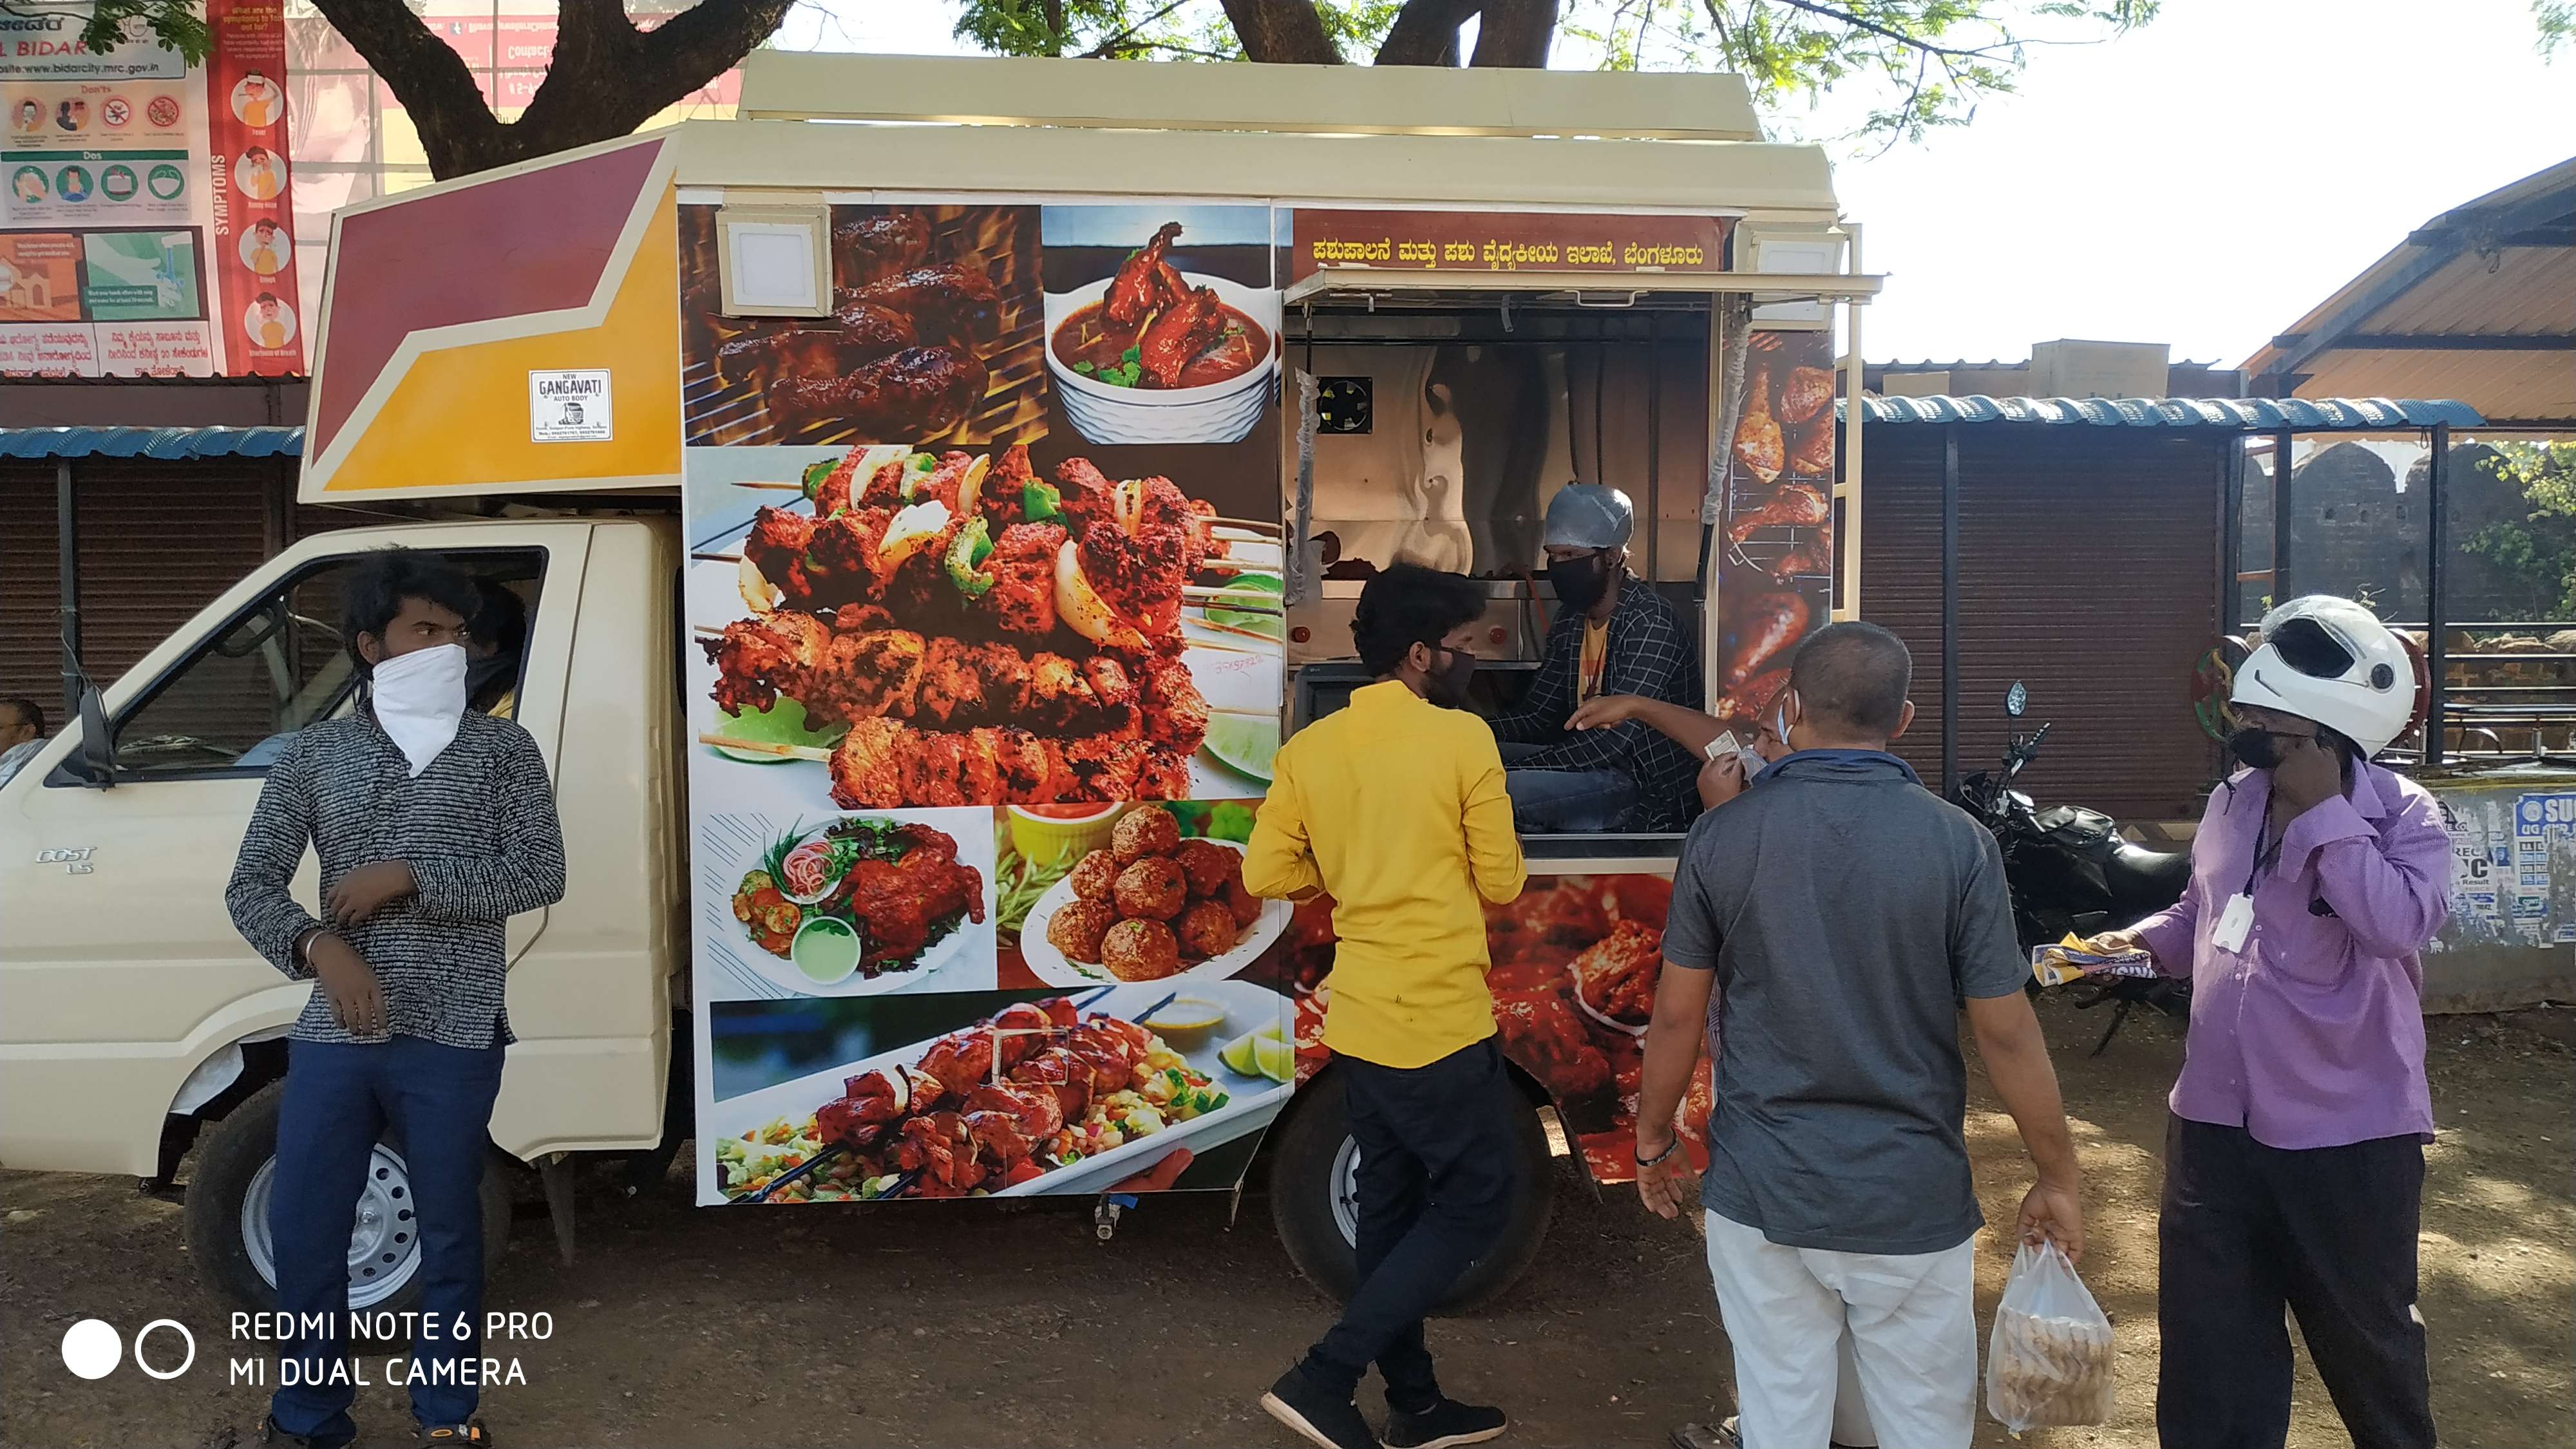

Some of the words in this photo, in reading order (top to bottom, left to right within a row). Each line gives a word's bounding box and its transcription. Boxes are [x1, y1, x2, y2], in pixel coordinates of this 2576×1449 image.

[17, 40, 88, 57] BIDAR
[83, 151, 102, 160] Dos
[211, 154, 229, 236] SYMPTOMS
[1313, 237, 1391, 260] ಪಶುಪಾಲನೆ
[1398, 238, 1437, 269] ಮತ್ತು
[1444, 239, 1475, 261] ಪಶು
[1483, 239, 1558, 270] ವೈದ್ಯಕೀಯ
[1566, 240, 1616, 265] ಇಲಾಖೆ,
[1624, 242, 1704, 265] ಬೆಂಗಳೂರು
[539, 379, 601, 395] GANGAVATI
[35, 846, 98, 864] DOST
[67, 862, 94, 875] LS
